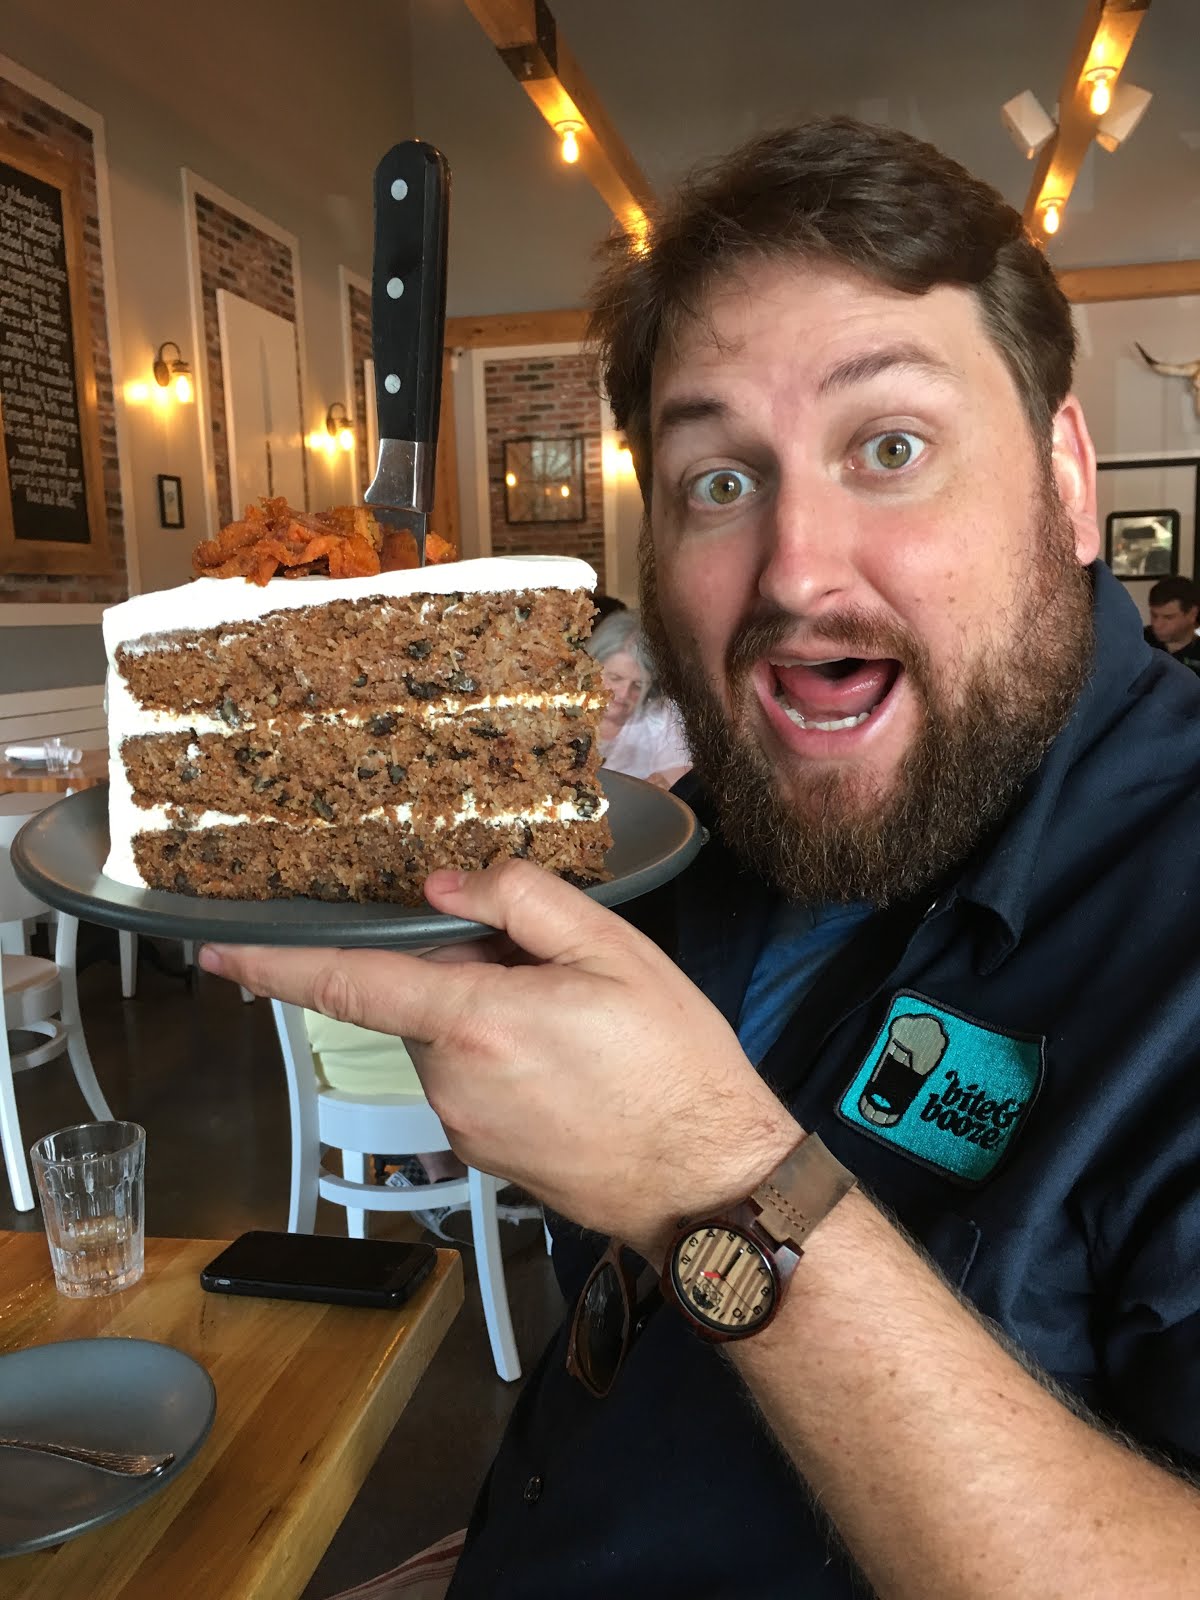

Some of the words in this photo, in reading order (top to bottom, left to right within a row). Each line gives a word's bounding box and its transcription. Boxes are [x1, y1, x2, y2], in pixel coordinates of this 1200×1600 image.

[688, 1236, 699, 1247] 3
[726, 1232, 737, 1242] 5
[681, 1254, 692, 1265] 2
[732, 1307, 746, 1322] 10
